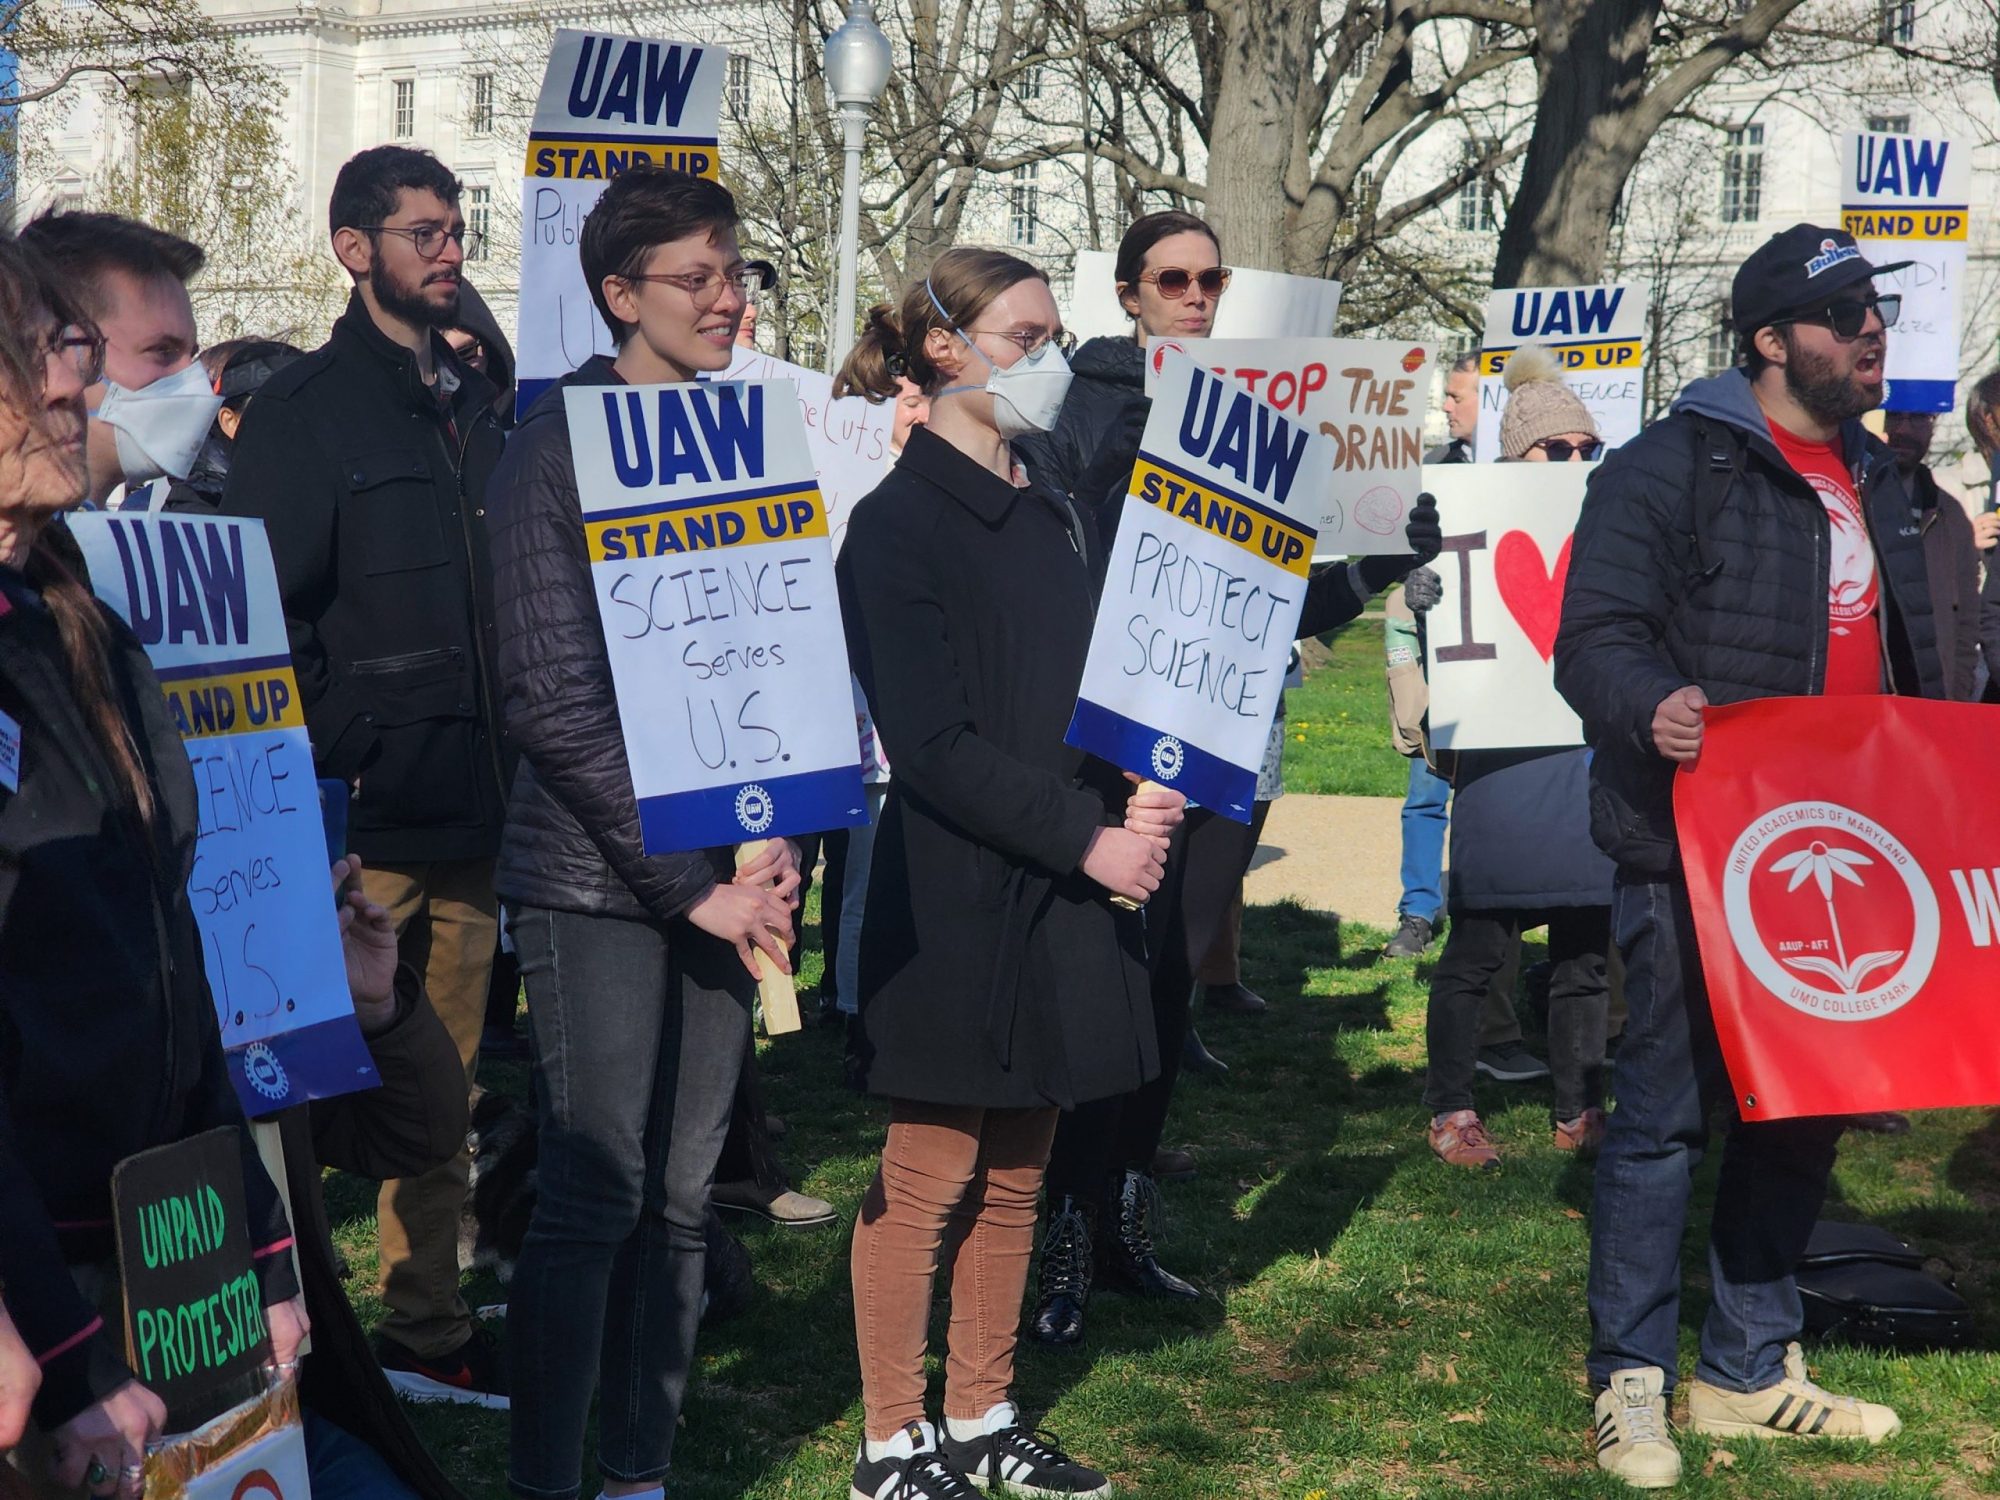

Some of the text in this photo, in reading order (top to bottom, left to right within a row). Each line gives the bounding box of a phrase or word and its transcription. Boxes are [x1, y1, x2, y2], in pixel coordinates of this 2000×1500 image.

[567, 36, 703, 128] UAW
[665, 152, 709, 179] UP
[1857, 134, 1949, 198] UAW
[534, 188, 581, 245] Publ
[1845, 216, 1960, 236] STAND UP
[1512, 287, 1625, 337] UAW
[1208, 361, 1415, 416] TOP THE
[1595, 347, 1633, 365] UP
[602, 385, 764, 488] UAW
[824, 398, 884, 460] Cuts
[1179, 367, 1309, 504] UAW
[601, 513, 745, 560] STAND
[757, 500, 815, 538] UP
[1139, 473, 1304, 565] STAND UP
[107, 519, 249, 645] UAW
[610, 558, 811, 639] SCIENCE
[1130, 532, 1291, 650] PROTECT
[1435, 529, 1497, 664] I
[683, 640, 785, 680] Serves
[1123, 614, 1267, 717] SCIENCE
[168, 678, 289, 738] AND UP
[686, 690, 791, 770] U.S.
[190, 743, 297, 840] IENCE
[1733, 808, 1907, 875] UNITED ACADEMICS OF MARYLAND
[190, 855, 281, 915] Serves
[1778, 940, 1804, 952] AAUP
[1811, 939, 1830, 950] AFT
[1790, 982, 1910, 1014] UMD COLLEGE PARK
[138, 1183, 225, 1269] UNPAID
[137, 1269, 267, 1382] PROTESTER
